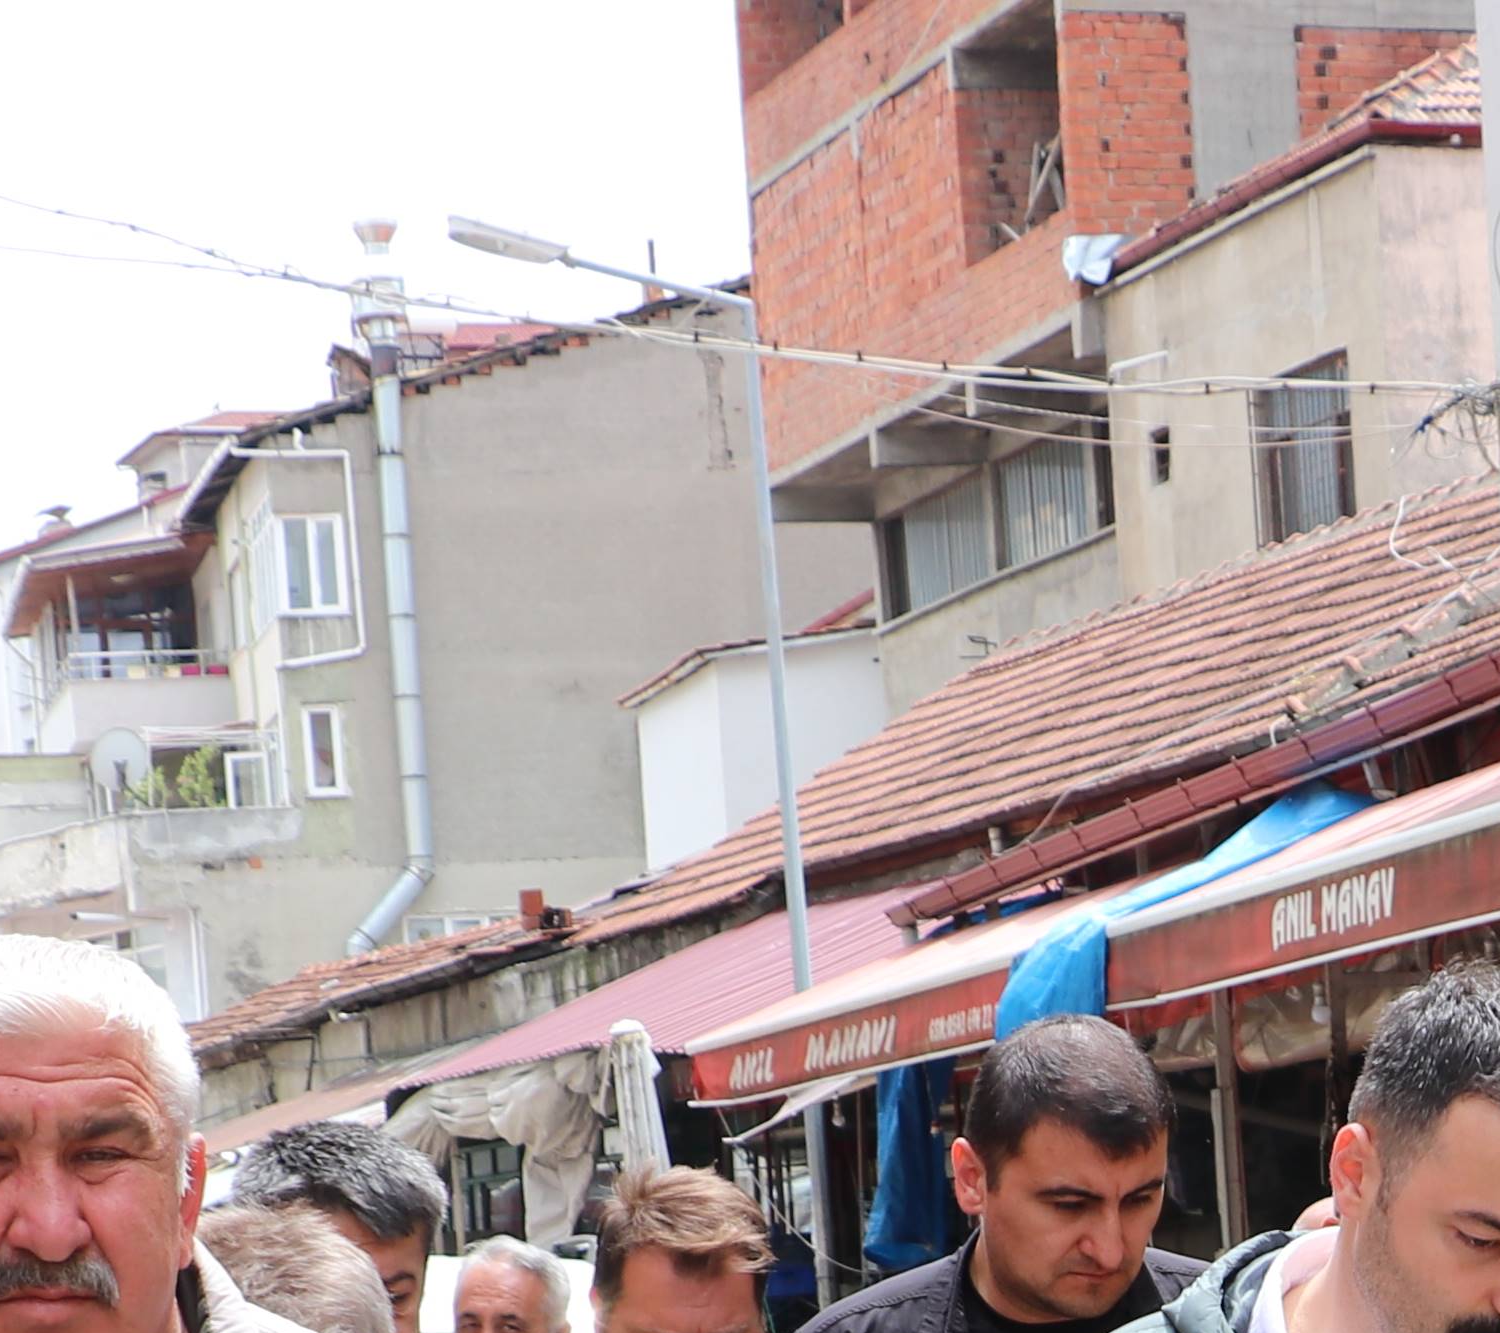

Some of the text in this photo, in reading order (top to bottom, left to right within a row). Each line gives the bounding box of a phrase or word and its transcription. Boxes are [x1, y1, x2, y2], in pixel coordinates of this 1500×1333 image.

[1271, 866, 1396, 952] ANIL MANAV
[803, 1013, 897, 1073] MANAVI
